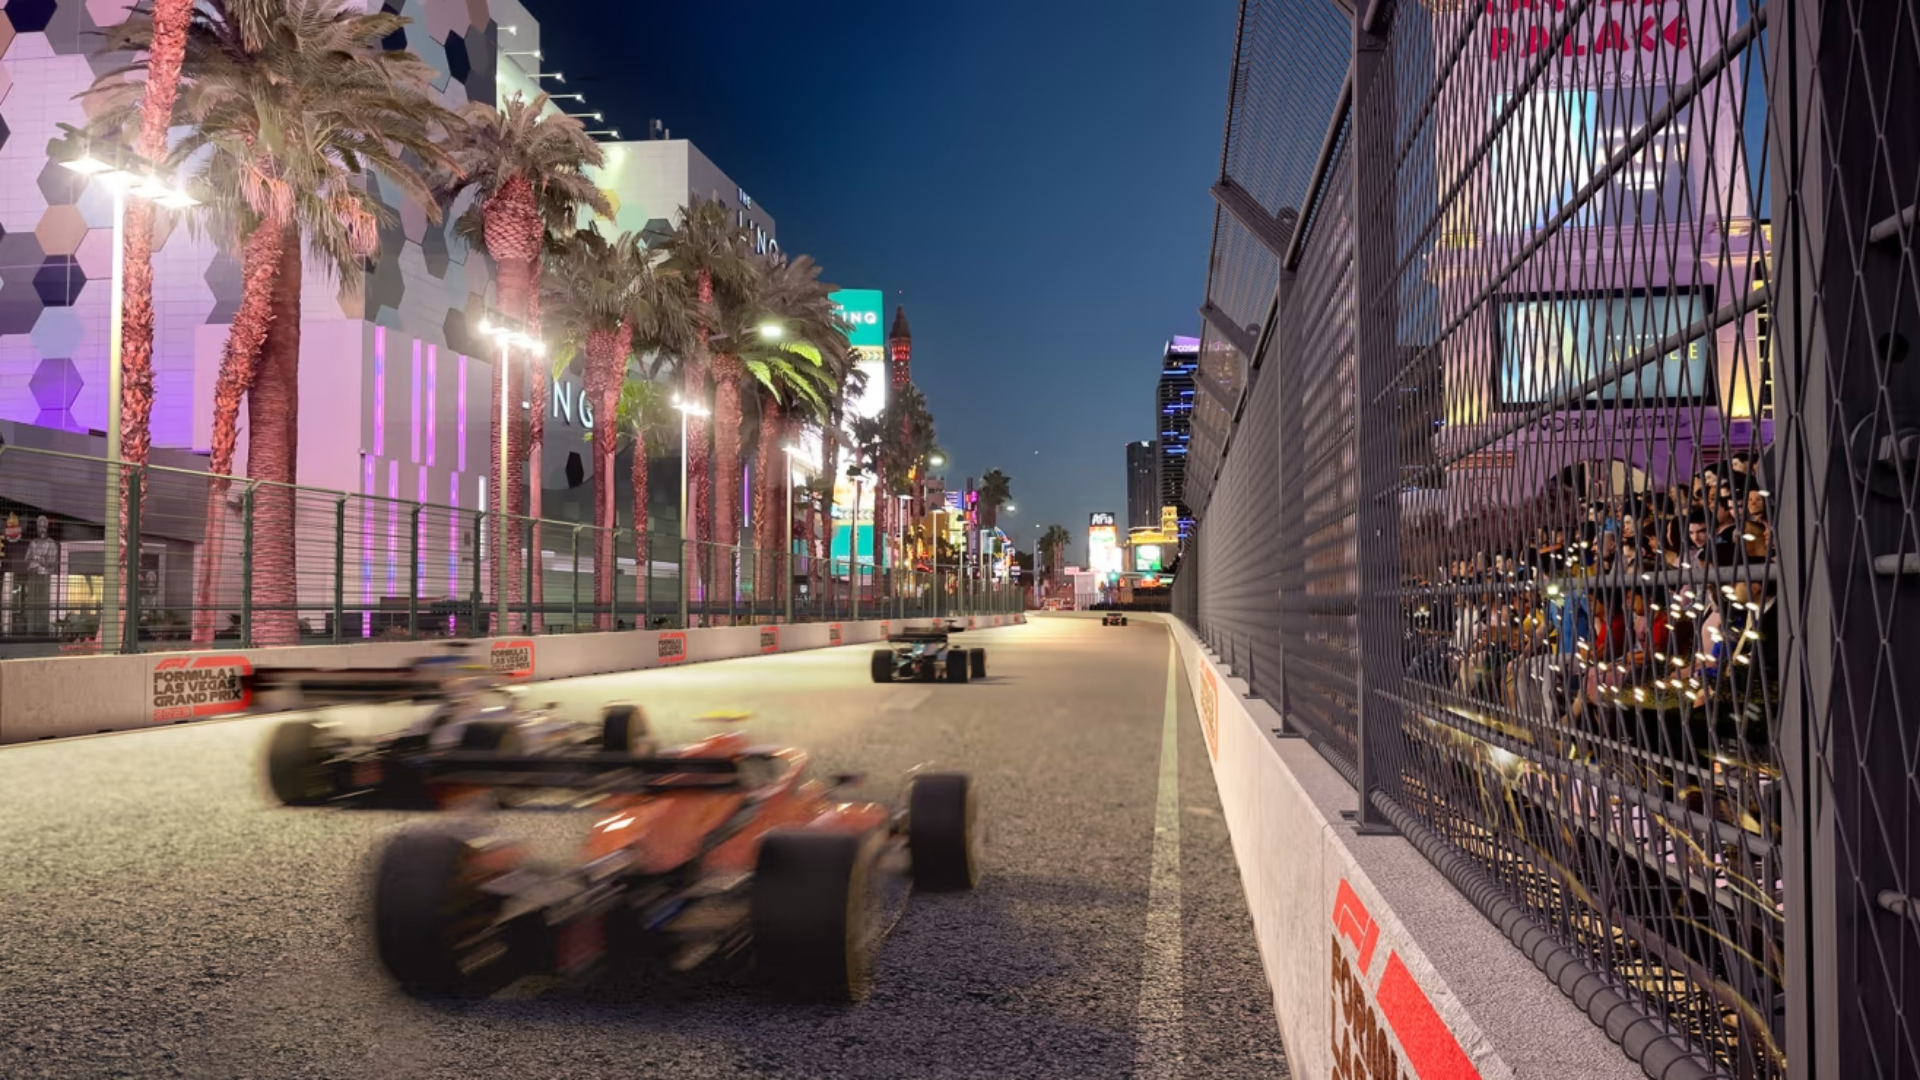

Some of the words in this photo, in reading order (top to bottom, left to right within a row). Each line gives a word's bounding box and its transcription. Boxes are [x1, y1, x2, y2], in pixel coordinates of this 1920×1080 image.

[1609, 343, 1699, 362] ADLE
[153, 669, 227, 683] FORMULA
[228, 667, 236, 678] 1
[153, 682, 184, 695] LAS
[187, 679, 236, 692] VEGAS
[153, 692, 207, 707] GRAND
[210, 690, 241, 702] PRIX
